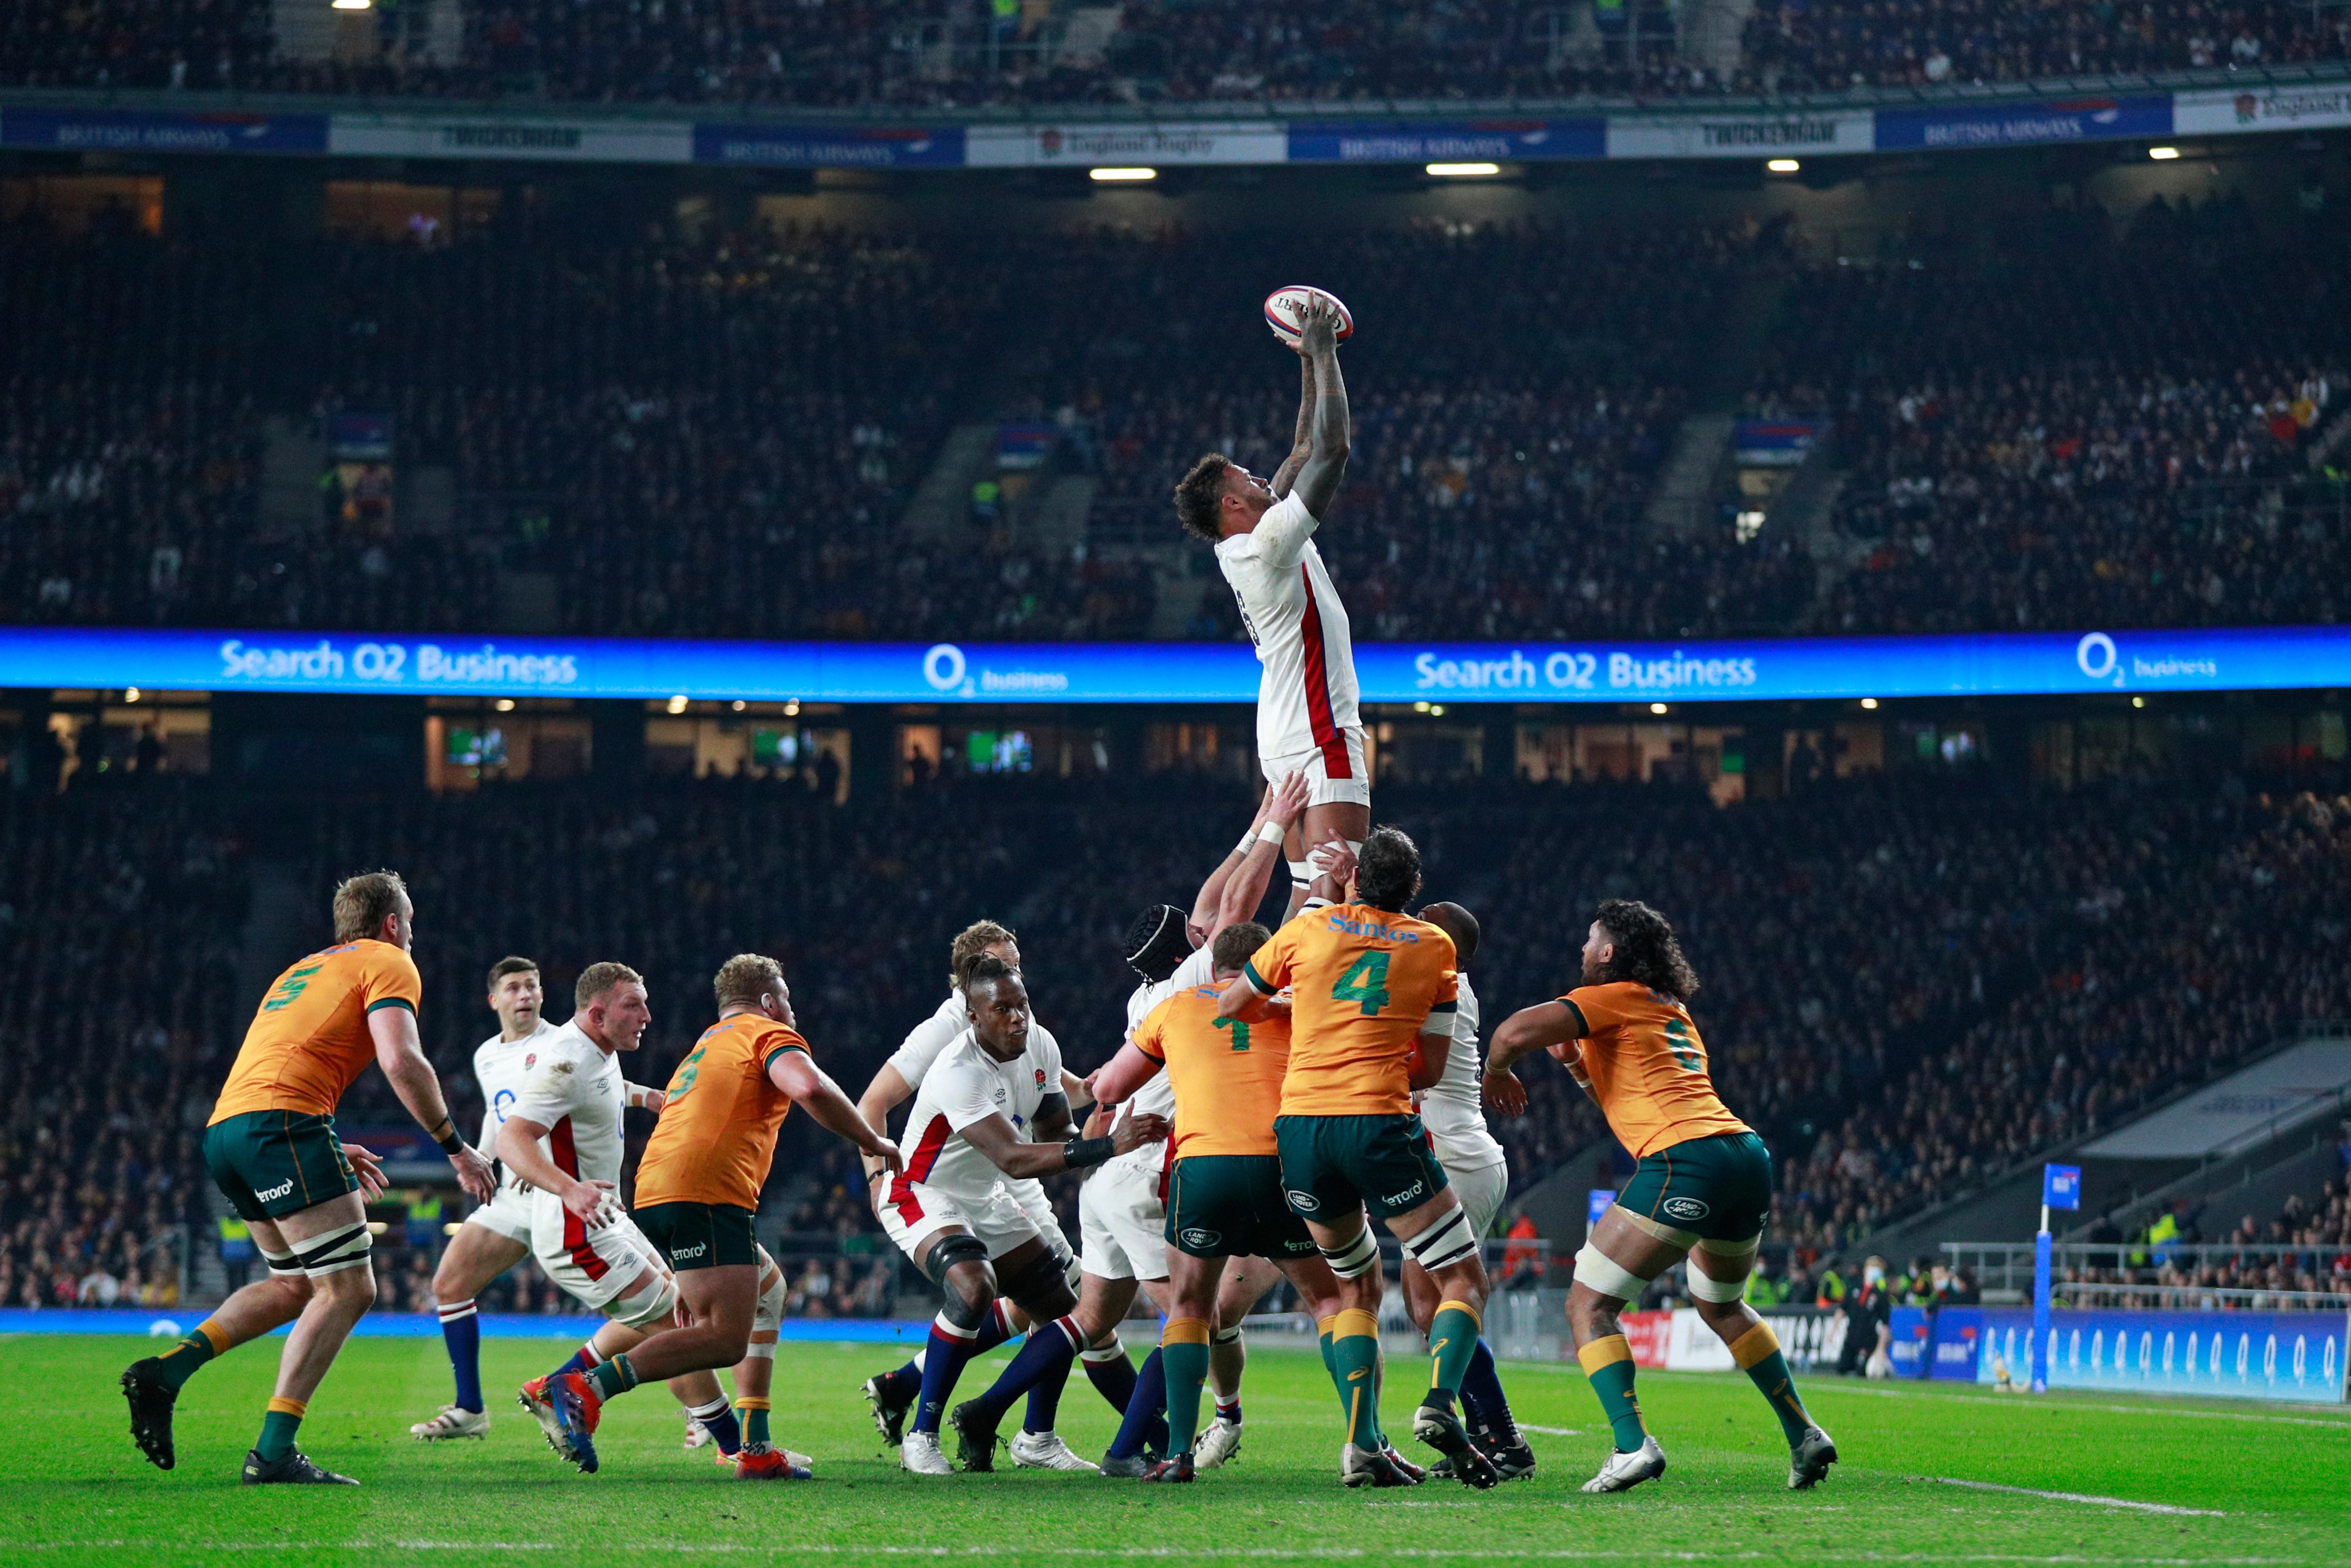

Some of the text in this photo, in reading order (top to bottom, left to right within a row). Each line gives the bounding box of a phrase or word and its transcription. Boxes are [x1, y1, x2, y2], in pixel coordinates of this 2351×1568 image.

[221, 640, 578, 684] Search O2 Business
[1415, 650, 1757, 690] Search O2 Business
[1328, 914, 1419, 944] Santos
[264, 964, 325, 1011] 5
[1331, 949, 1391, 1016] 4
[1212, 1016, 1249, 1051] 1
[667, 1047, 706, 1103] 3
